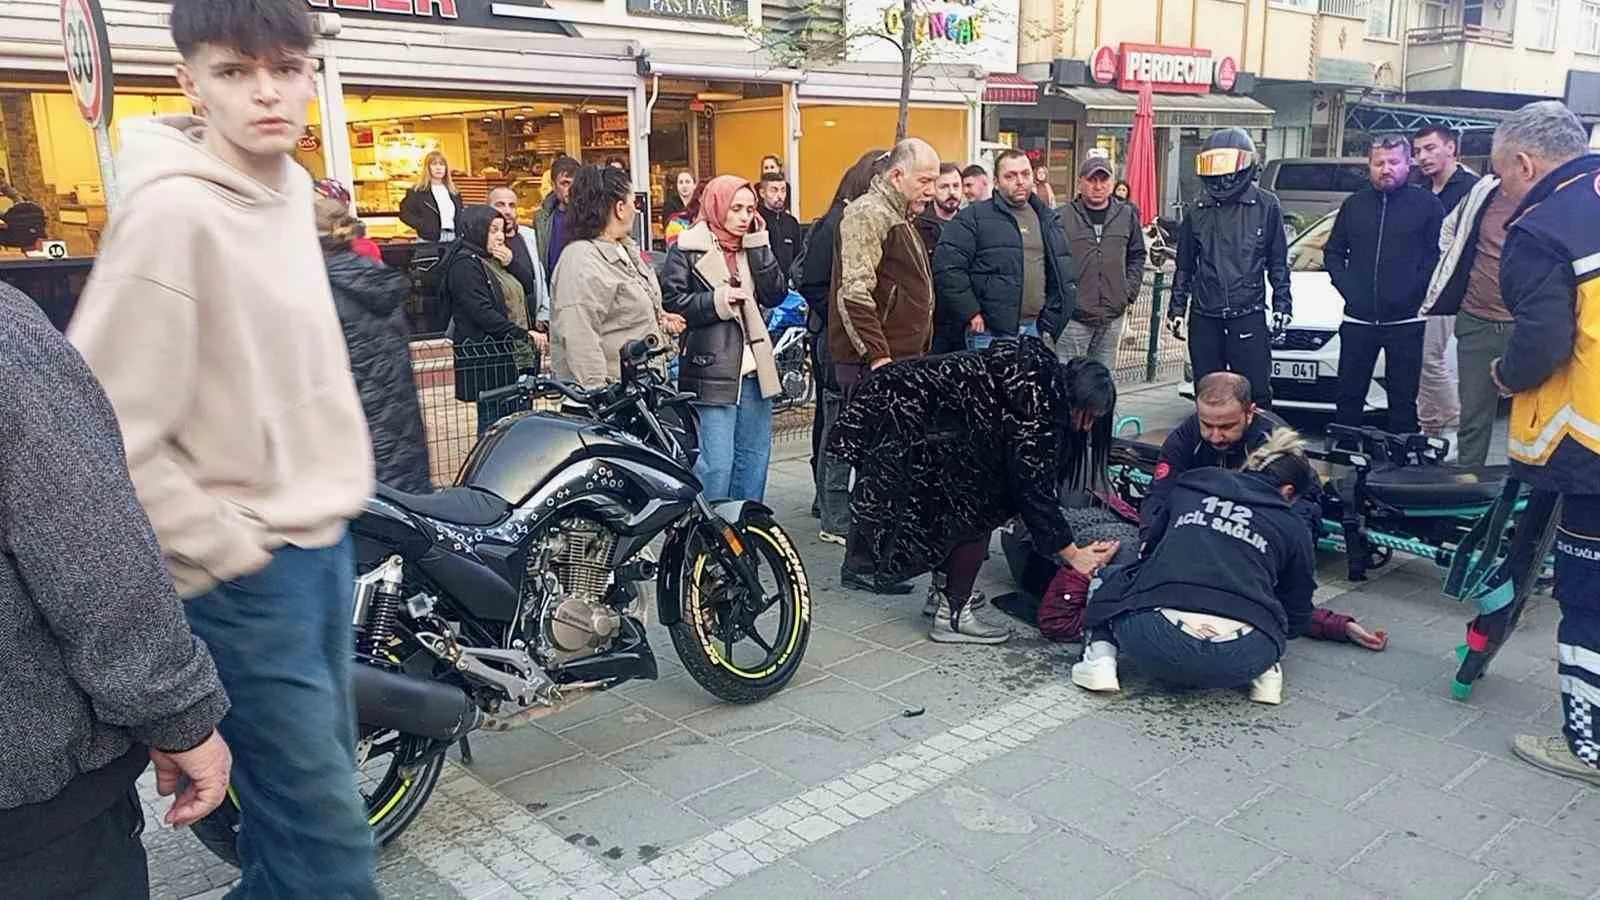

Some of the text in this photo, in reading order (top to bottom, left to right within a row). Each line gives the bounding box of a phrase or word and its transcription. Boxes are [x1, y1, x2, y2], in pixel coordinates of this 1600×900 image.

[885, 8, 984, 45] OUNCAK
[68, 20, 93, 83] 30
[1292, 363, 1314, 377] 041
[1202, 496, 1253, 526] 112
[1174, 510, 1269, 553] ACİL SAĞLIK
